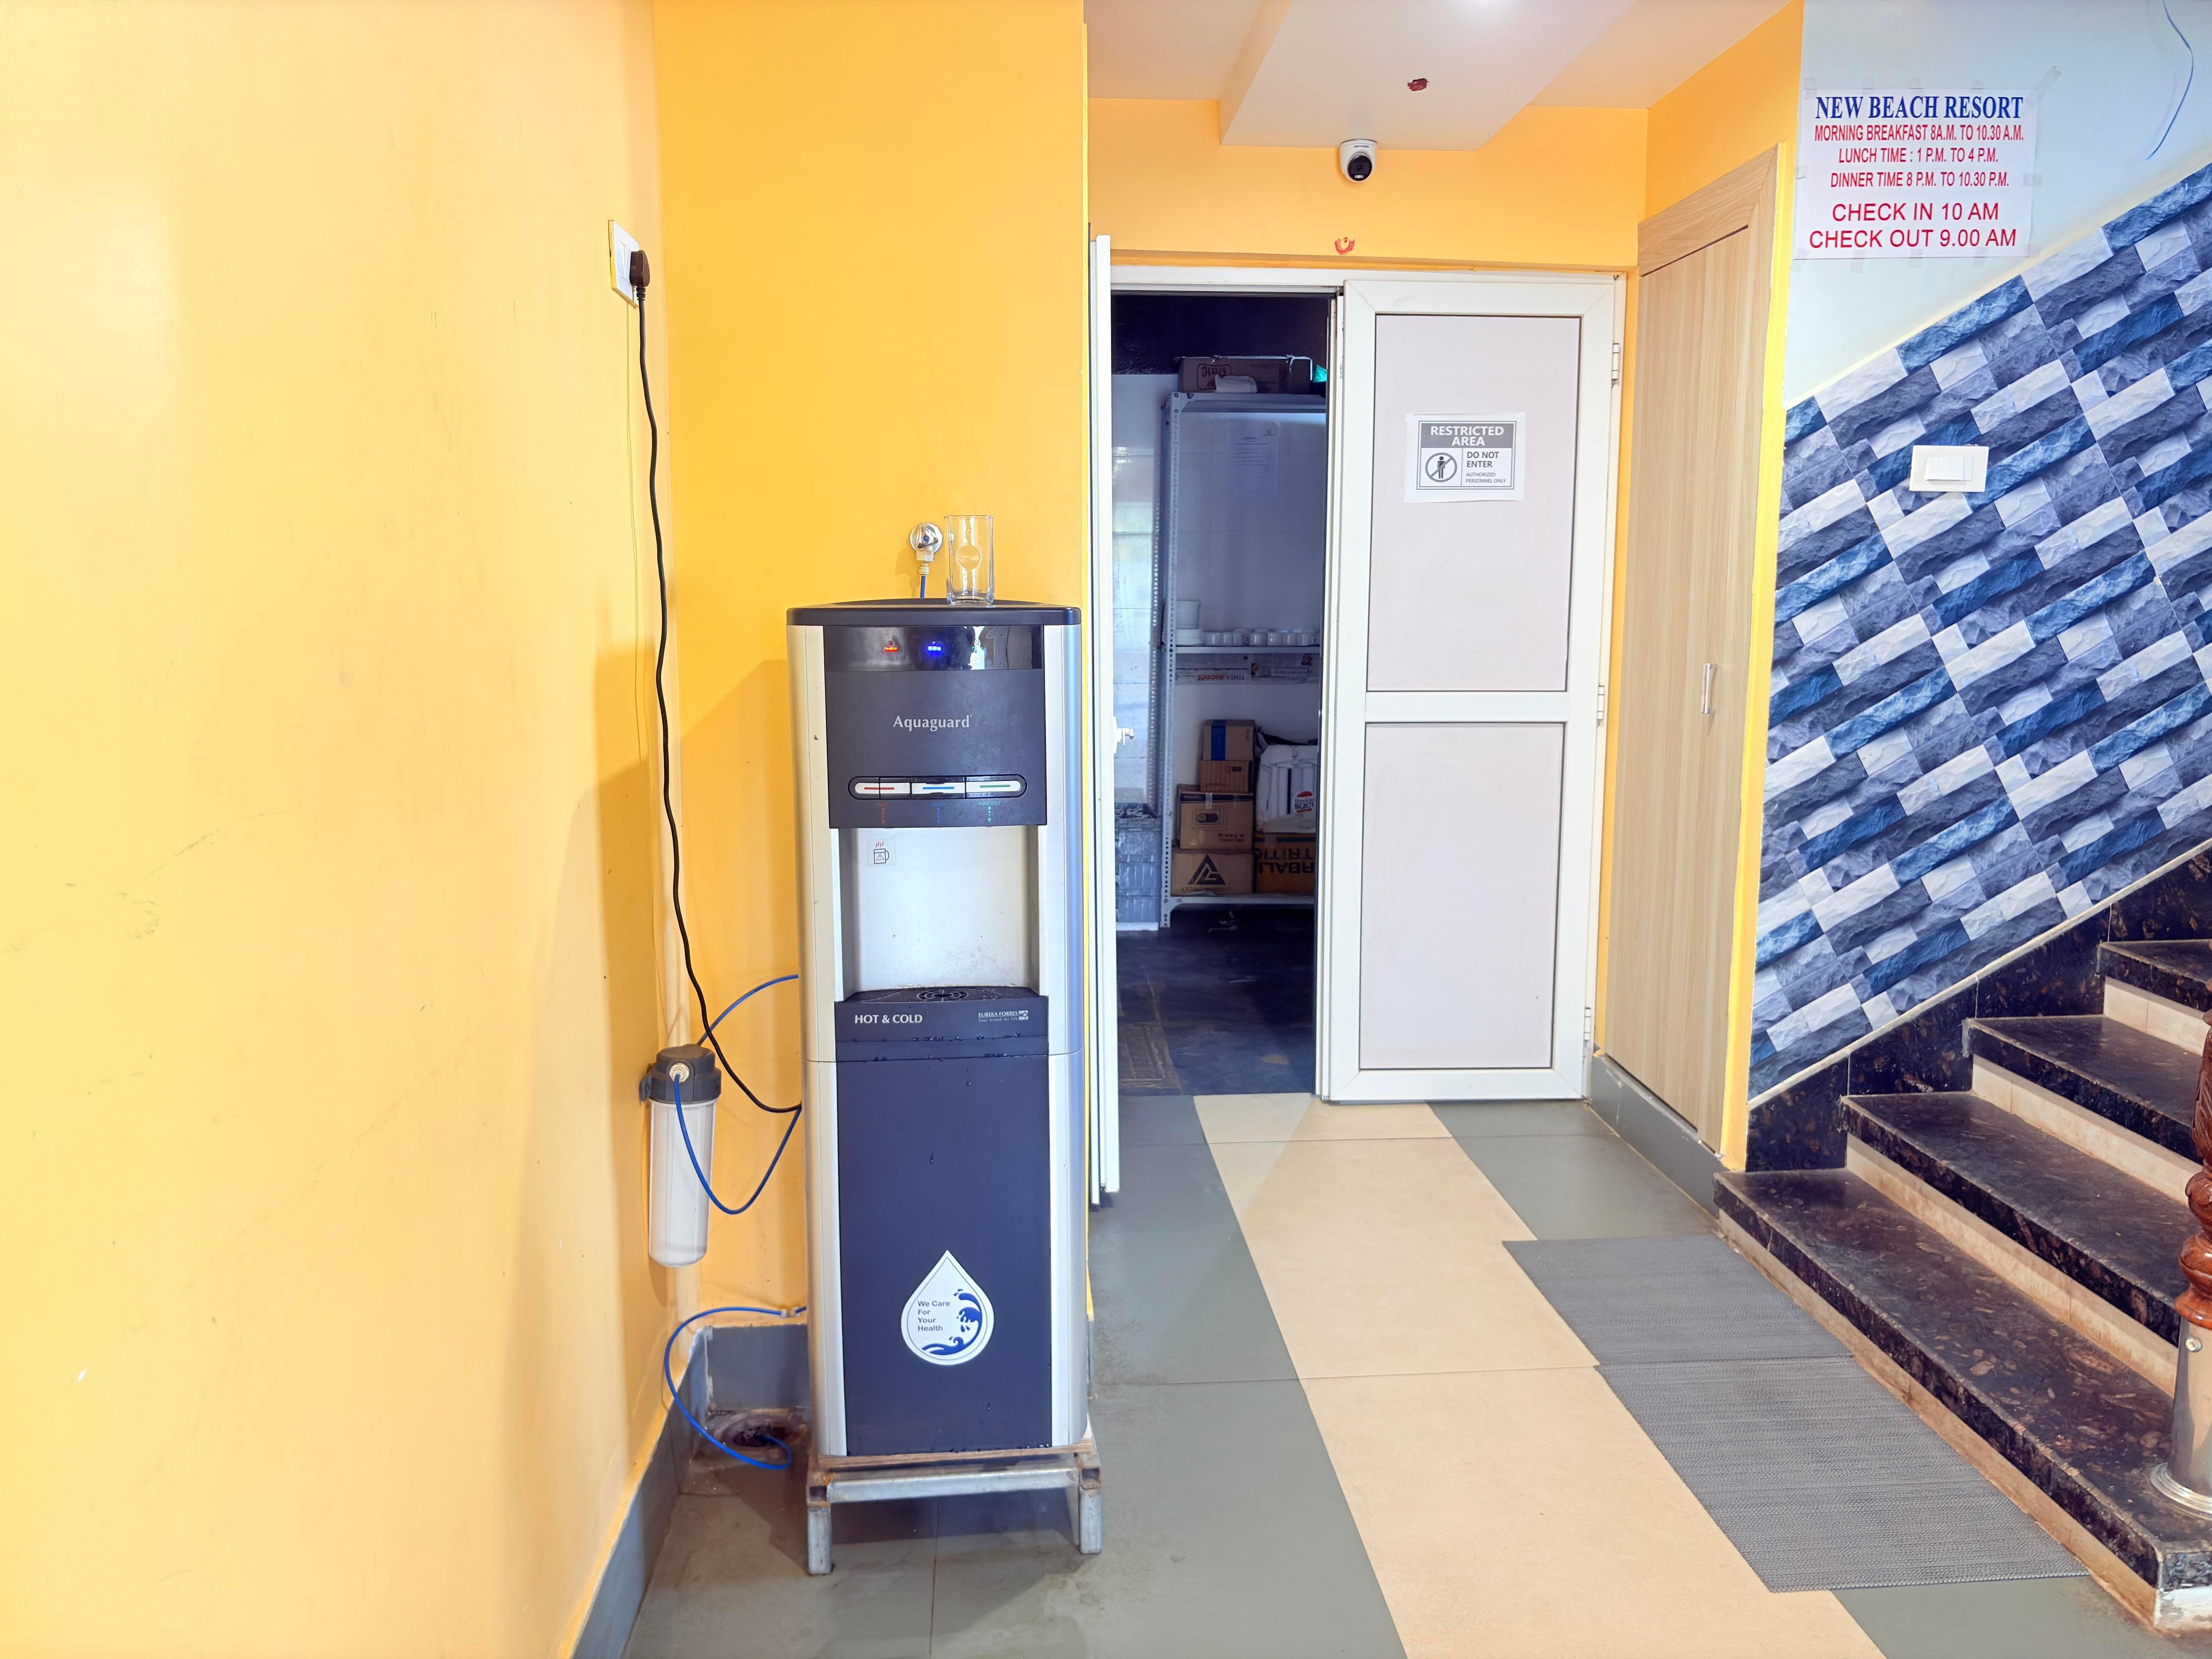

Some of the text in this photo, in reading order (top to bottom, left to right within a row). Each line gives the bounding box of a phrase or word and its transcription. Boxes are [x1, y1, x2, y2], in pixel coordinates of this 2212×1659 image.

[1815, 96, 2024, 119] NEW BEACH RESORT
[1815, 124, 2024, 142] MORNING BREAKFAST 8A.M. TO 10.30 A.M.
[1839, 147, 1877, 163] LUNCH
[1881, 147, 1907, 163] TIME
[1917, 147, 1922, 163] 1
[1925, 147, 1947, 163] P.M.
[1950, 147, 1965, 162] TO
[1968, 147, 1974, 162] 4
[1978, 147, 1999, 162] P.M.
[1831, 172, 2009, 187] DINNER TIME 8 P.M. TO 10.30 P.M.
[1833, 203, 1999, 221] CHECK IN 10 AM
[1810, 229, 2016, 248] CHECK OUT 9.00 AM
[1430, 426, 1504, 436] RESTRICTED
[1452, 437, 1485, 446] AREA
[893, 714, 970, 732] Aquaguard
[855, 1014, 923, 1023] HOT & COLD
